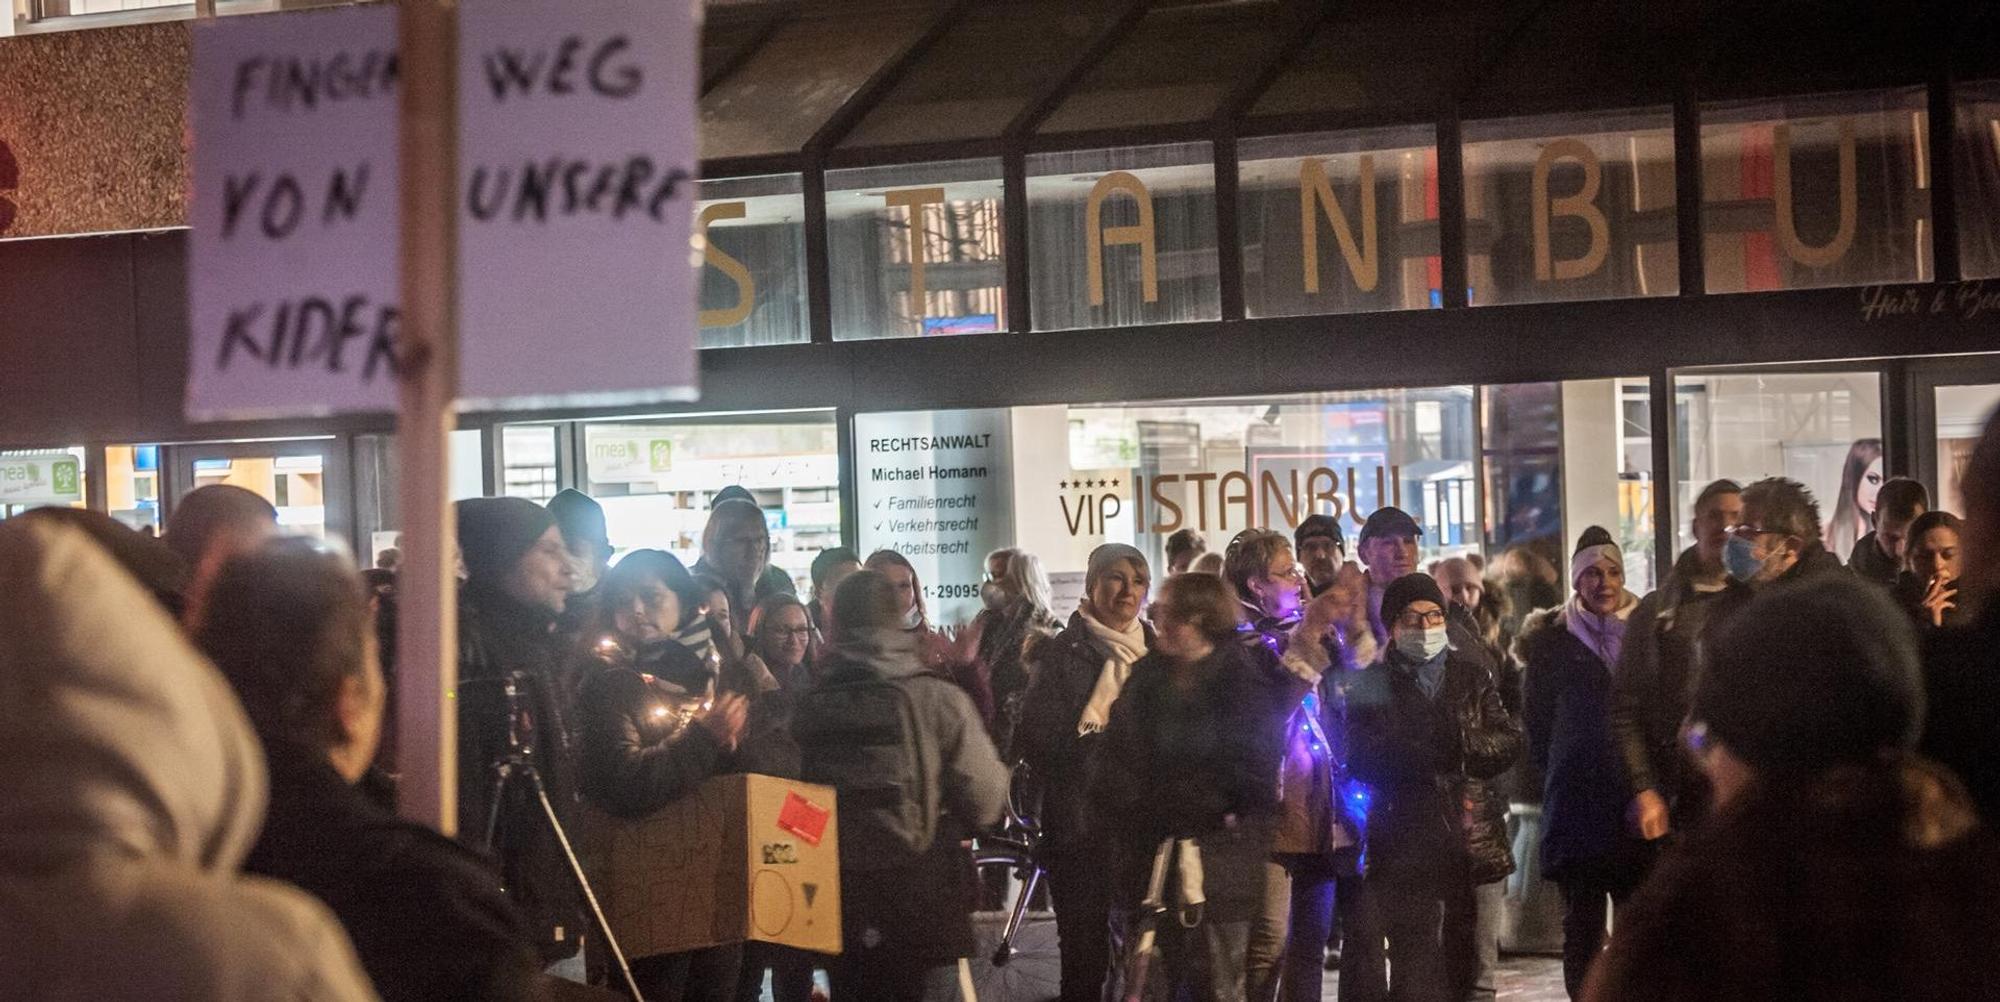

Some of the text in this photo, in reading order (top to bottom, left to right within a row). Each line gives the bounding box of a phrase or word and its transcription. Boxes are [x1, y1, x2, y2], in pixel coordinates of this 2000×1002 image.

[481, 34, 643, 101] WEG
[466, 156, 689, 223] UNSERE
[595, 443, 625, 457] mea
[869, 433, 992, 454] RECHTSANWALT
[871, 465, 988, 482] Michael Homann
[888, 494, 977, 510] Familienrecht
[1059, 493, 1121, 536] VIP
[889, 517, 979, 533] Verkehrsrecht
[891, 540, 970, 556] Arbeitsrecht
